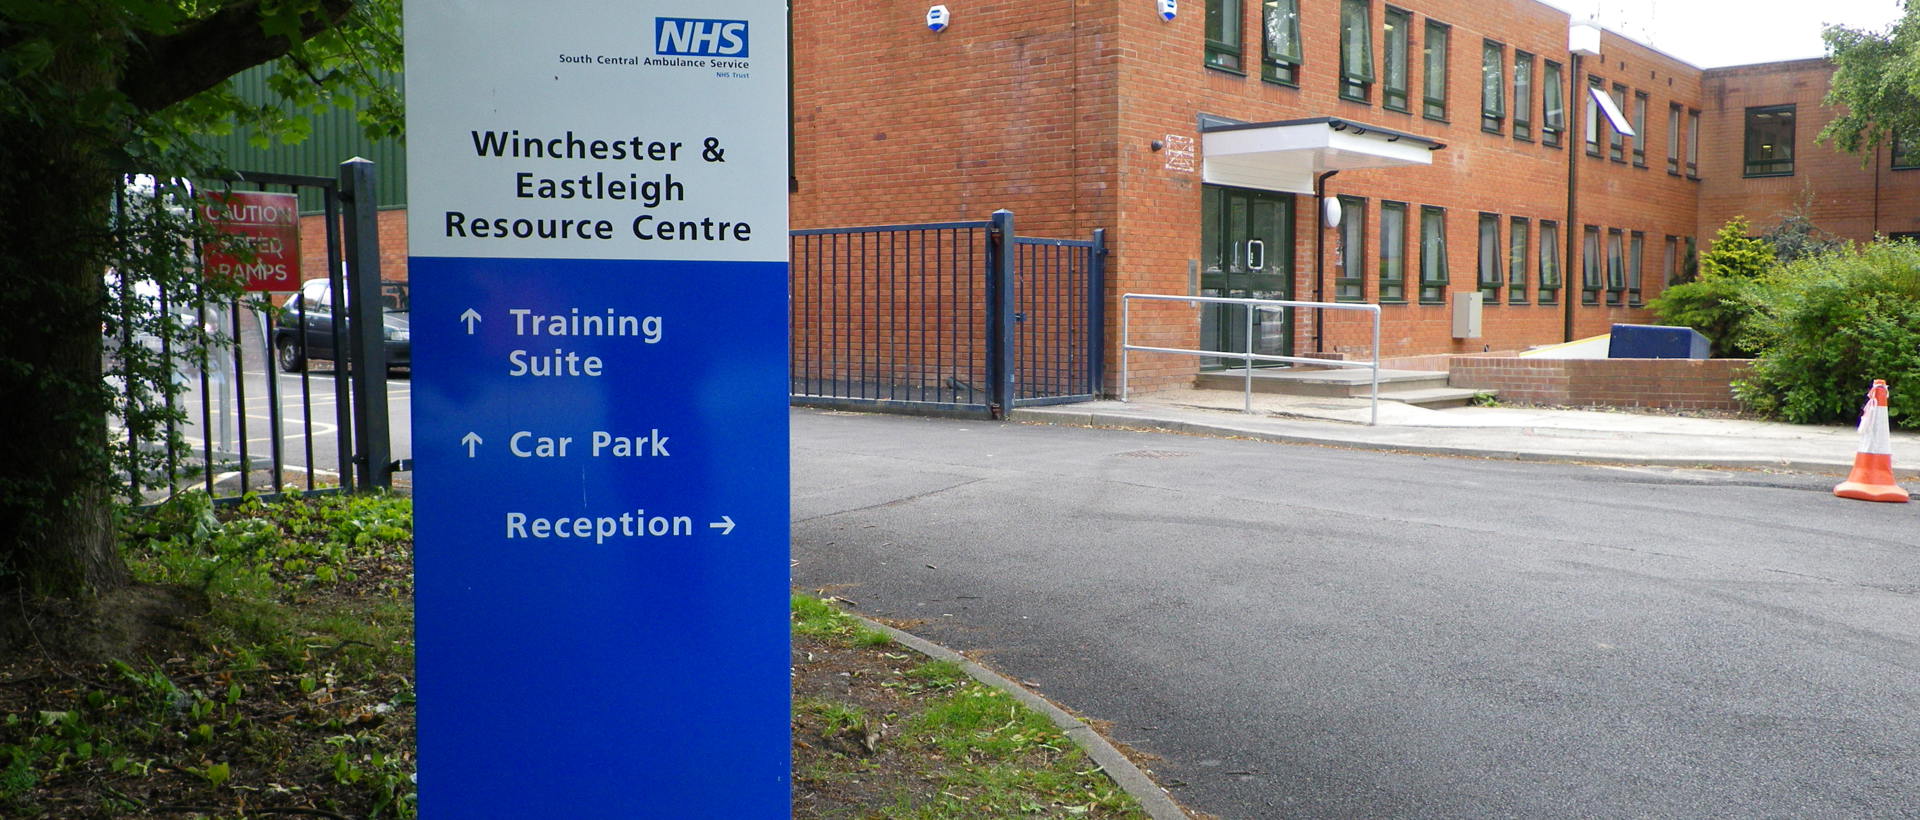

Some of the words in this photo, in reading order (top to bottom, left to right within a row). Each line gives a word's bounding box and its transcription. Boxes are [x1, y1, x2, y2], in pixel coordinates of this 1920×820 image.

[658, 20, 746, 54] NHS
[560, 54, 592, 64] South
[597, 55, 639, 66] Central
[644, 56, 706, 68] Ambulance
[710, 59, 750, 69] Service
[471, 130, 683, 161] Winchester
[702, 136, 726, 163] &
[516, 172, 685, 208] Eastleigh
[445, 211, 614, 239] Resource
[632, 214, 752, 241] Centre
[509, 308, 663, 344] Training
[509, 349, 603, 377] Suite
[509, 430, 572, 458] Car
[592, 428, 670, 458] Park
[506, 509, 693, 544] Reception
